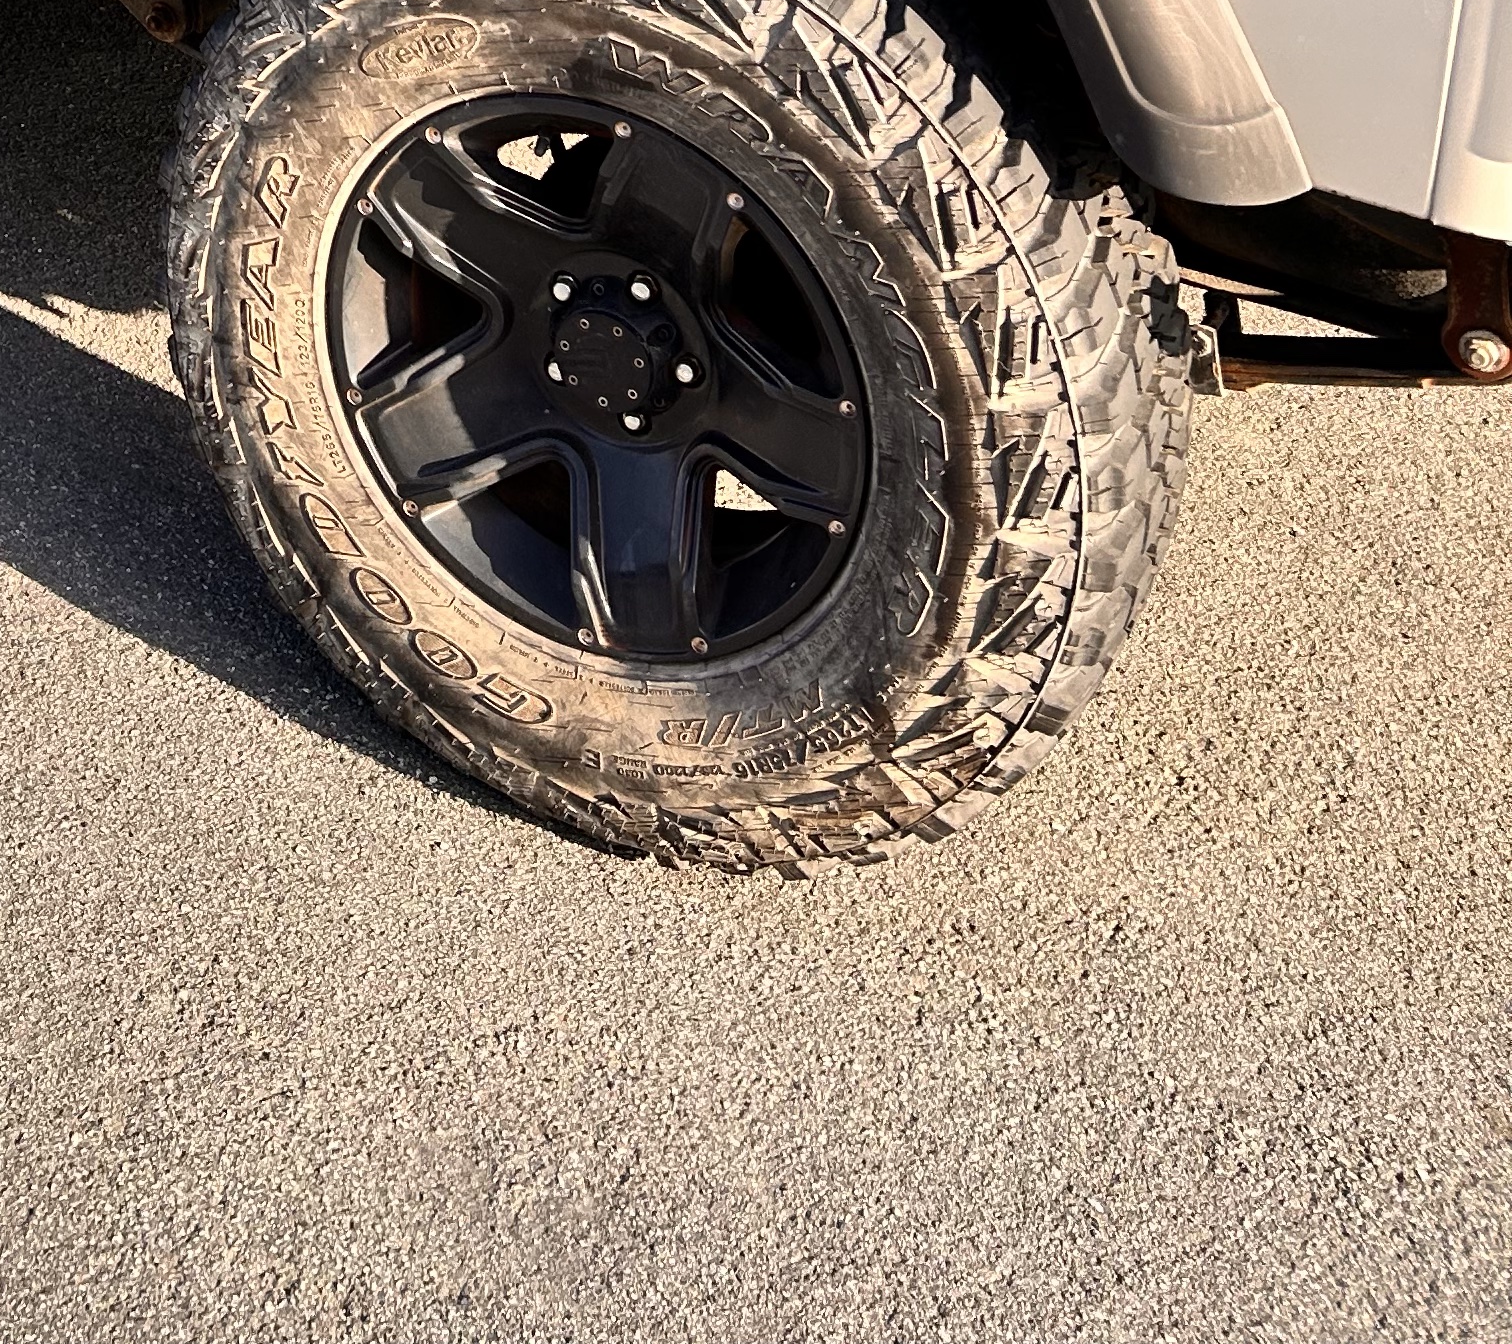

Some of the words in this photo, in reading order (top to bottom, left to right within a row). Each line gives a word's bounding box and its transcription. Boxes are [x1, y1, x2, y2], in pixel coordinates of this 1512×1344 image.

[374, 25, 467, 74] Kevlar
[238, 154, 554, 724] GOODYEAR
[659, 678, 825, 747] MT/R
